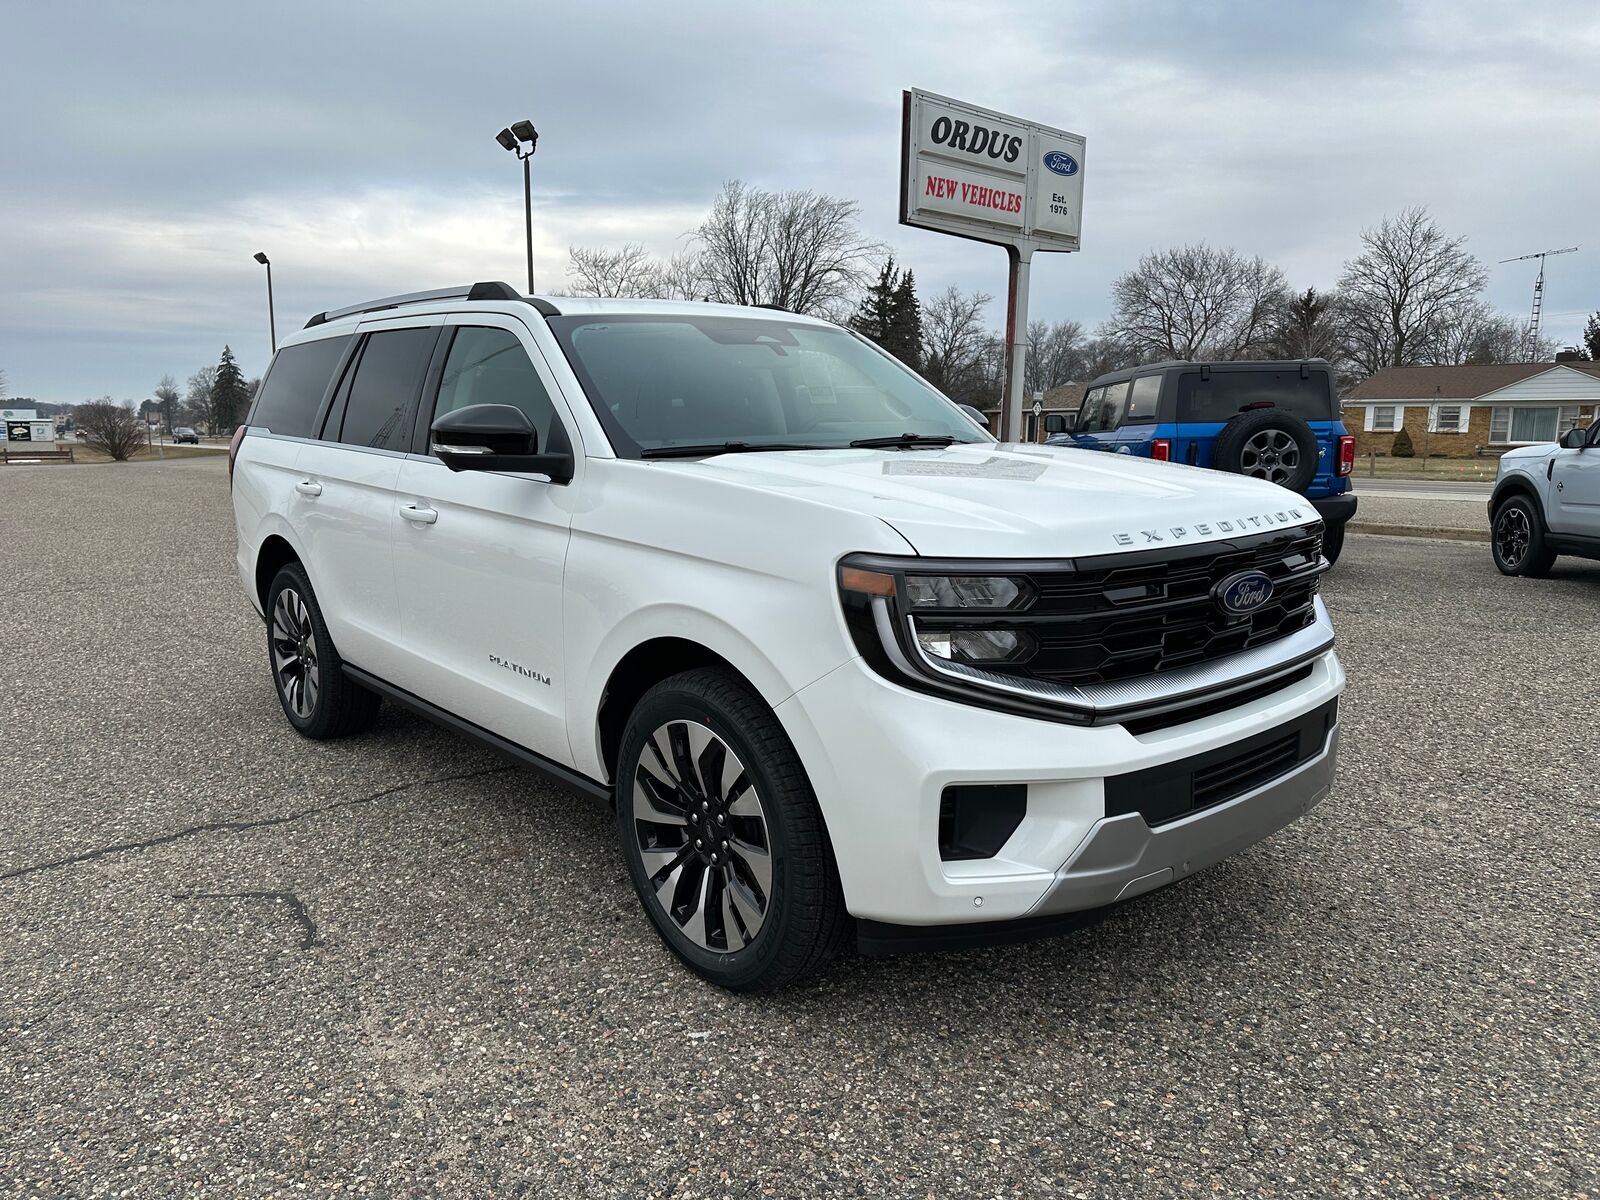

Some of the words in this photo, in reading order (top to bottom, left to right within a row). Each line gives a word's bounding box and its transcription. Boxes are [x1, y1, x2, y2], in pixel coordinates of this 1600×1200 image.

[931, 116, 1022, 163] ORDUS
[1050, 153, 1071, 172] Ford
[925, 175, 958, 200] NEW
[962, 182, 1022, 214] VEHICLES
[1052, 193, 1067, 204] Est.
[1049, 204, 1068, 216] 1976
[1112, 508, 1303, 546] EXPEDITION
[1234, 580, 1265, 608] Ford
[489, 654, 551, 686] PLATINUM
